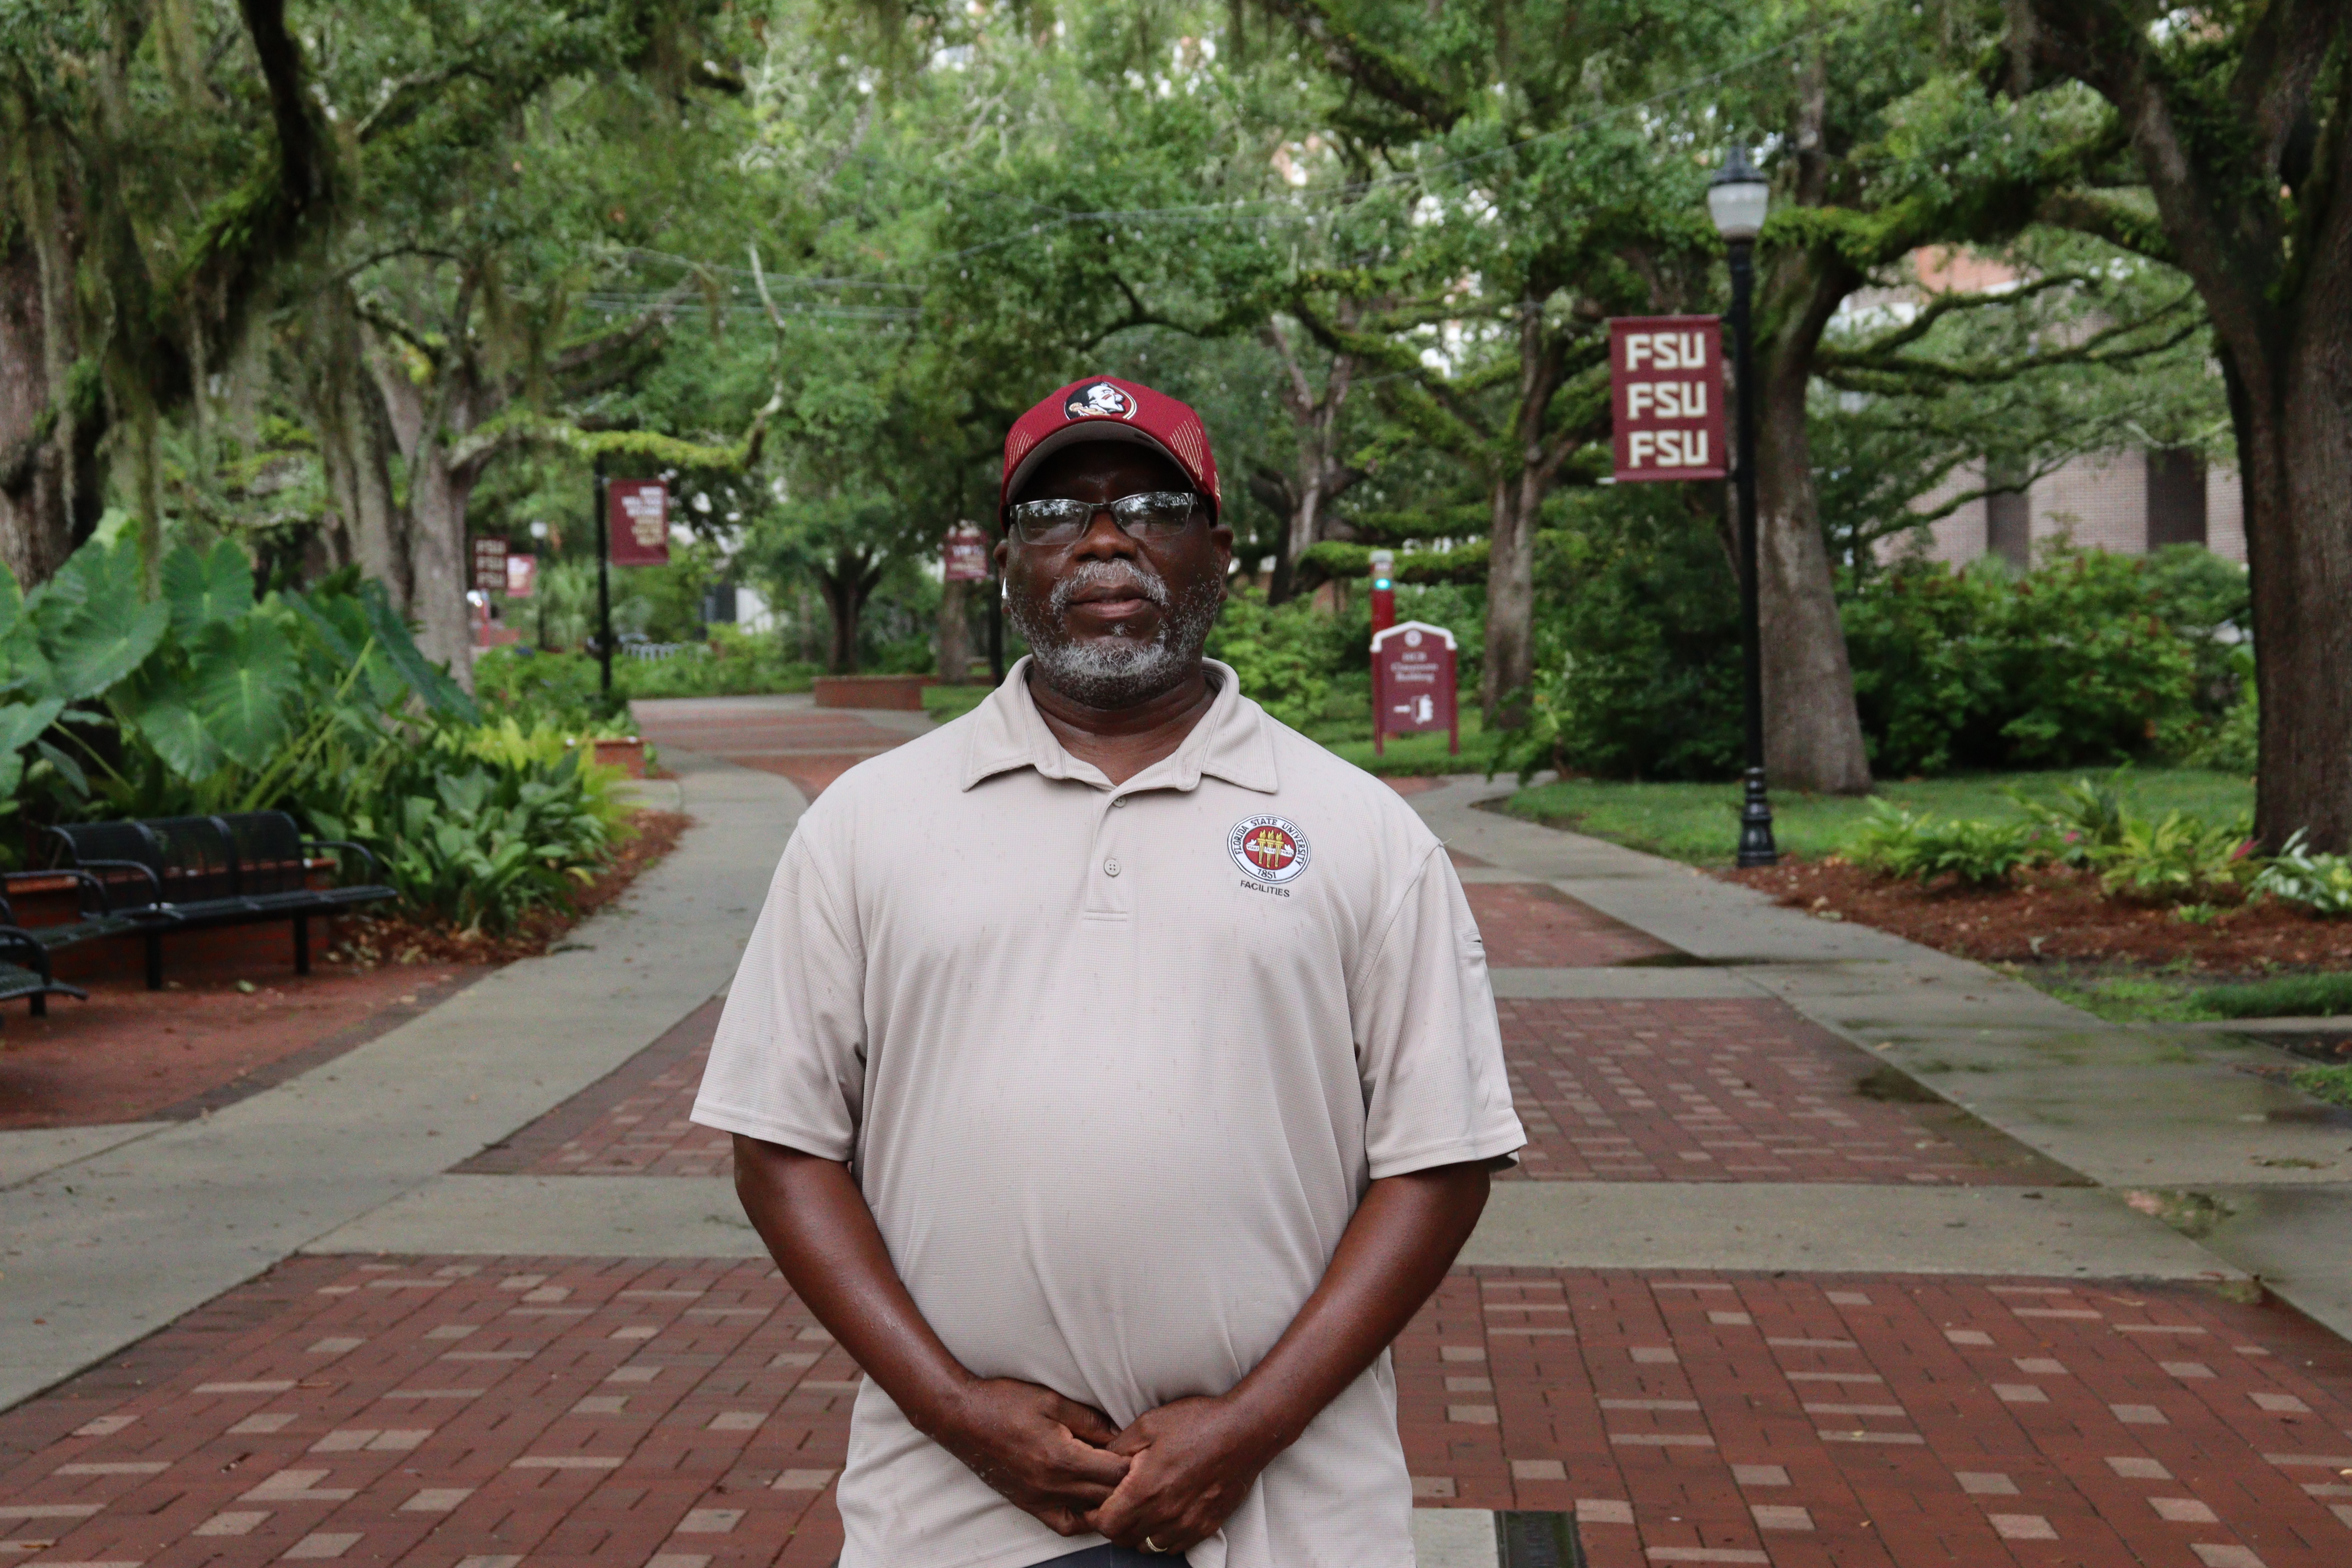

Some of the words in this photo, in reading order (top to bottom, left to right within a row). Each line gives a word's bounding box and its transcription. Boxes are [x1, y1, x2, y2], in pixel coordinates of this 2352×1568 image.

[1625, 332, 1706, 371] FSU
[1627, 381, 1707, 420] FSU
[1628, 429, 1709, 468] FSU
[1233, 826, 1249, 855] FLORIDA
[1250, 818, 1278, 826] STATE
[1281, 822, 1306, 867] UNIVERSITY
[1240, 880, 1290, 897] FACILITIES
[1258, 868, 1276, 879] 1851
